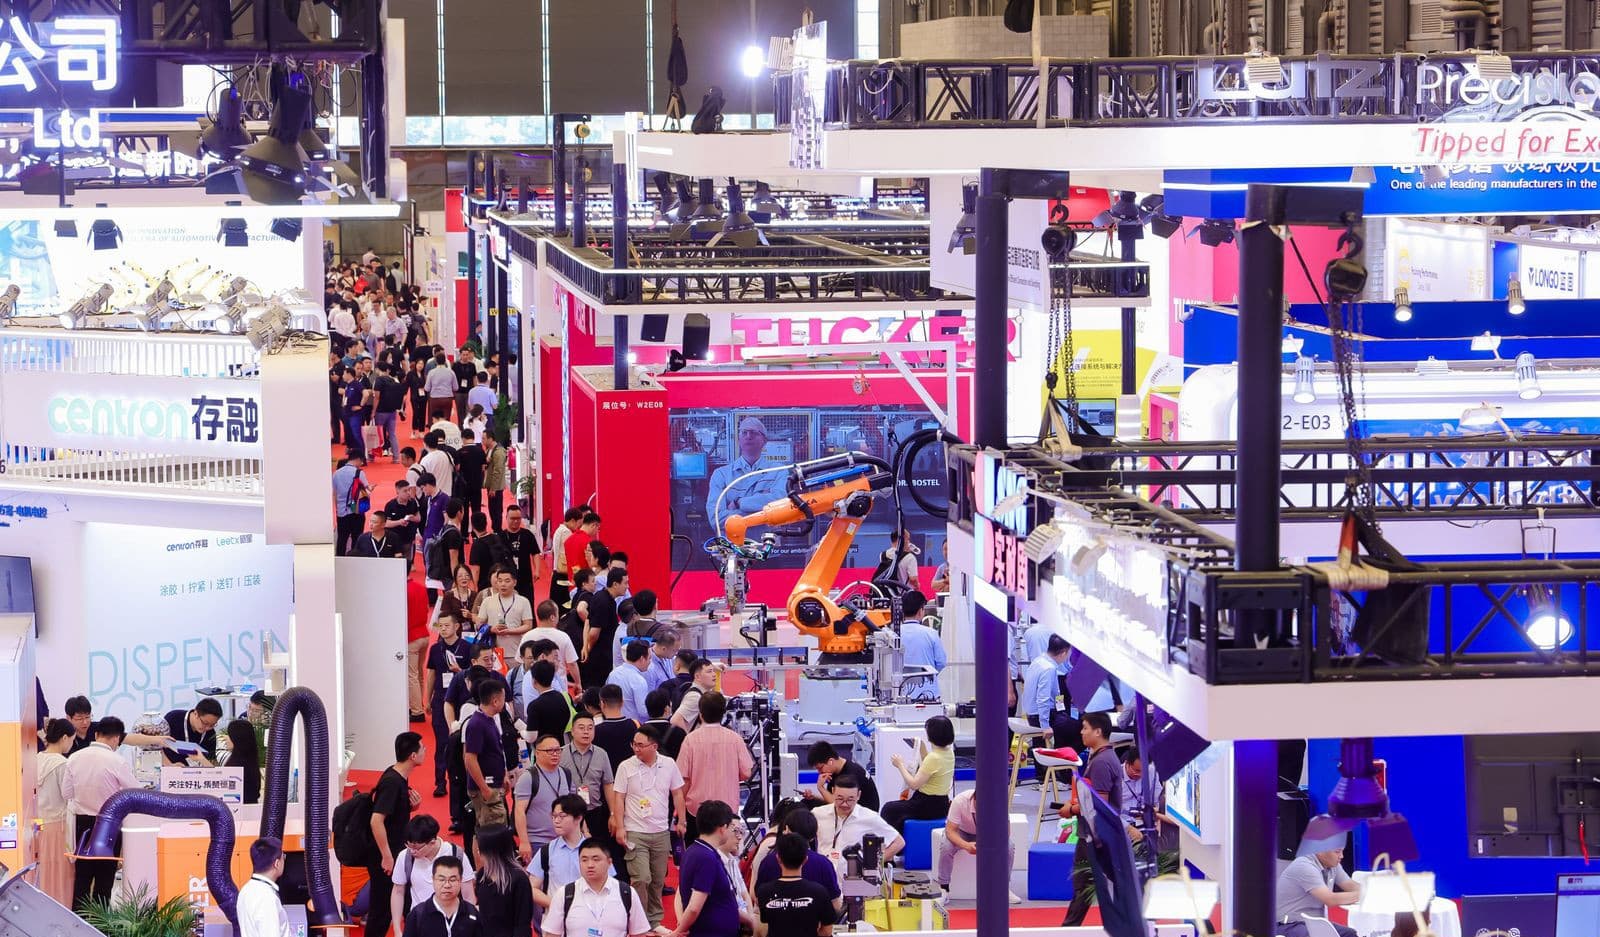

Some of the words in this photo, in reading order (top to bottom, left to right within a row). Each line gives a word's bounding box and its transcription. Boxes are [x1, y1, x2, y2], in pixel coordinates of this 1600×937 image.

[33, 108, 111, 148] Ltd.
[1418, 128, 1507, 160] Tipped
[1517, 128, 1554, 159] for
[1565, 128, 1600, 153] Ex
[1391, 179, 1412, 190] One
[1450, 179, 1487, 191] leading
[1491, 178, 1563, 189] manufacturers
[1566, 178, 1577, 189] in
[1580, 178, 1597, 189] the
[1535, 267, 1559, 289] LONGO
[731, 316, 1016, 363] TUCKE
[48, 397, 190, 440] centron
[191, 395, 259, 443] 存融
[188, 580, 206, 593] 拧紧
[216, 577, 234, 590] 送钉
[243, 574, 262, 587] 压装
[168, 780, 202, 790] 关注好礼
